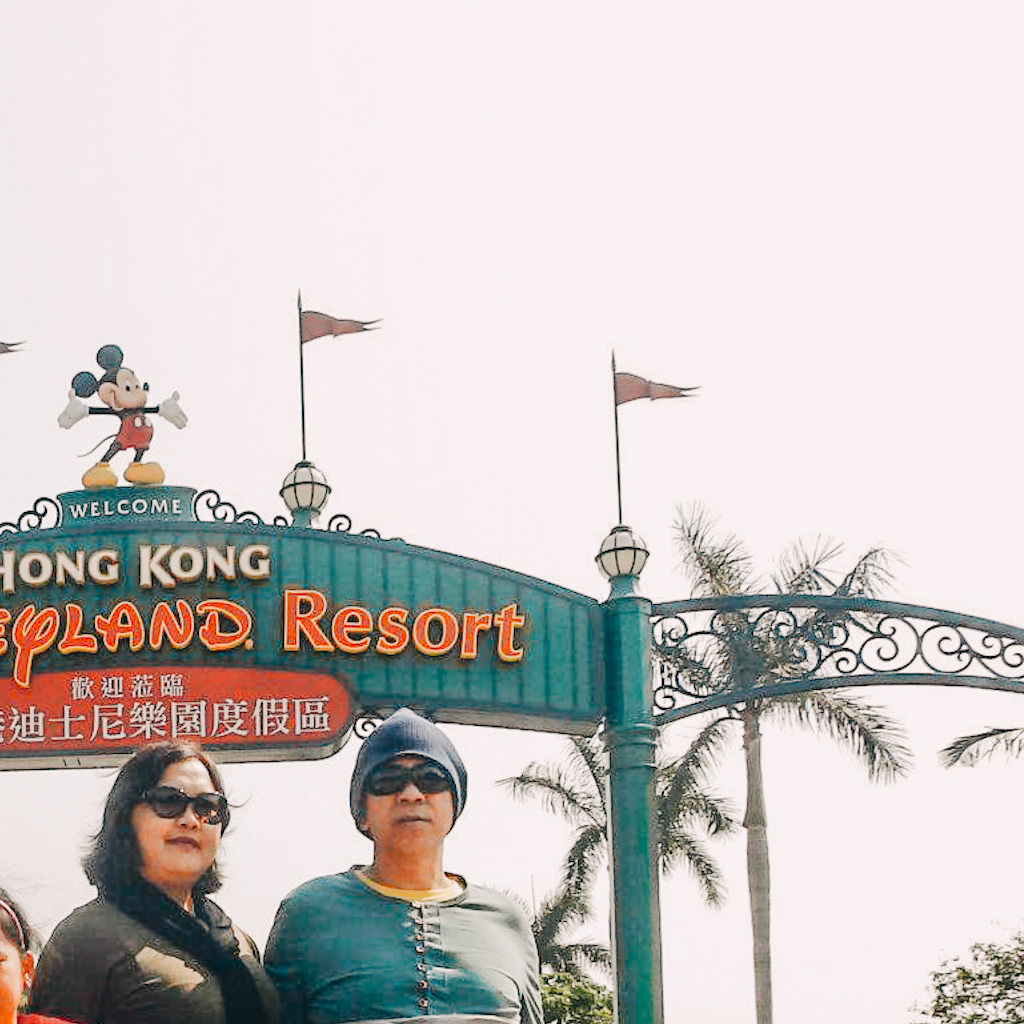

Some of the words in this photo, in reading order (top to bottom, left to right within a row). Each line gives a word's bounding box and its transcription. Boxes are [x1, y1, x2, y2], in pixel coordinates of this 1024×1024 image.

[70, 498, 182, 518] WELCOME
[138, 544, 271, 590] KONG
[283, 589, 525, 661] Resort
